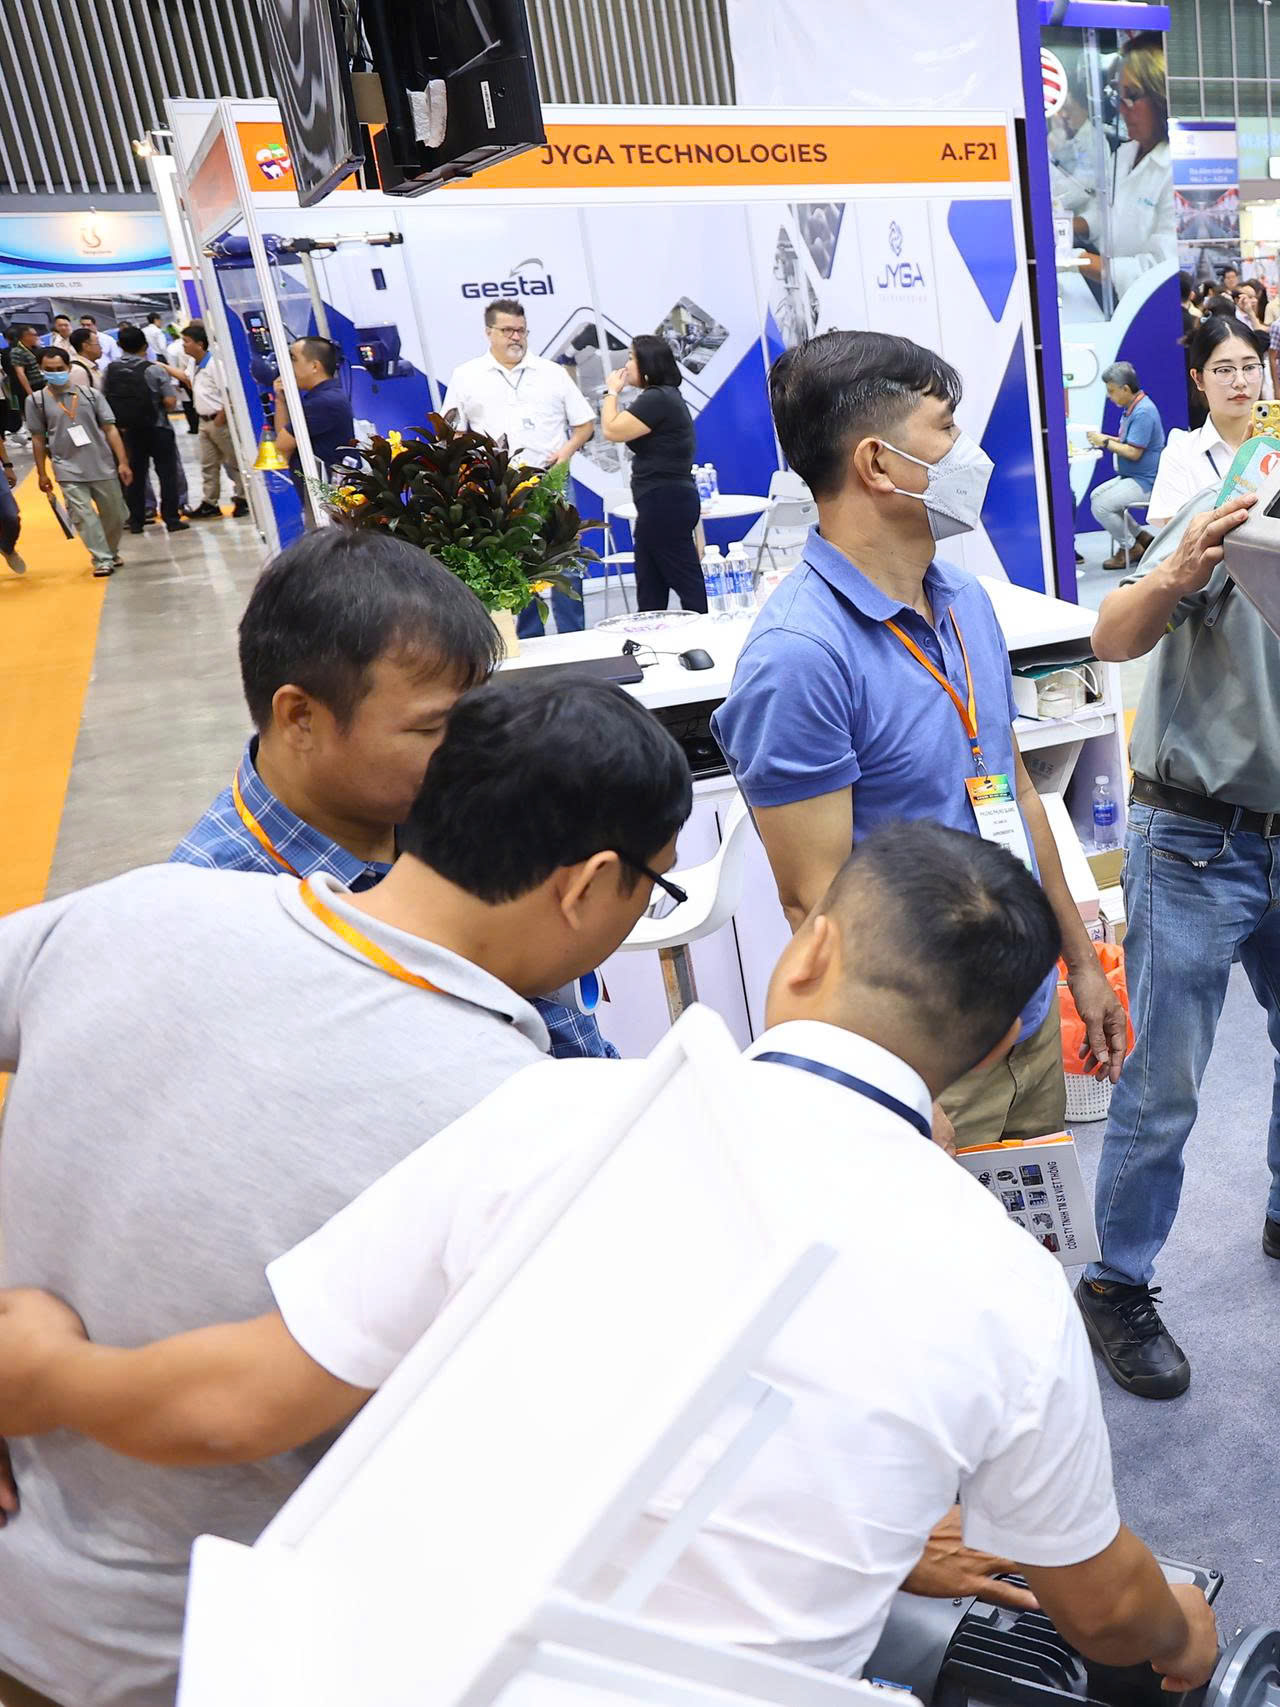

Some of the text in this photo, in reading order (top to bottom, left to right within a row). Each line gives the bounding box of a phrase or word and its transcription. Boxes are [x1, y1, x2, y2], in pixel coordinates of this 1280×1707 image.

[541, 142, 998, 165] JYGA TECHNOLOGIES A.F21
[461, 274, 555, 299] Gestal
[877, 262, 925, 289] JYGA
[1060, 1211, 1071, 1227] TNHH
[1063, 1227, 1073, 1235] TY
